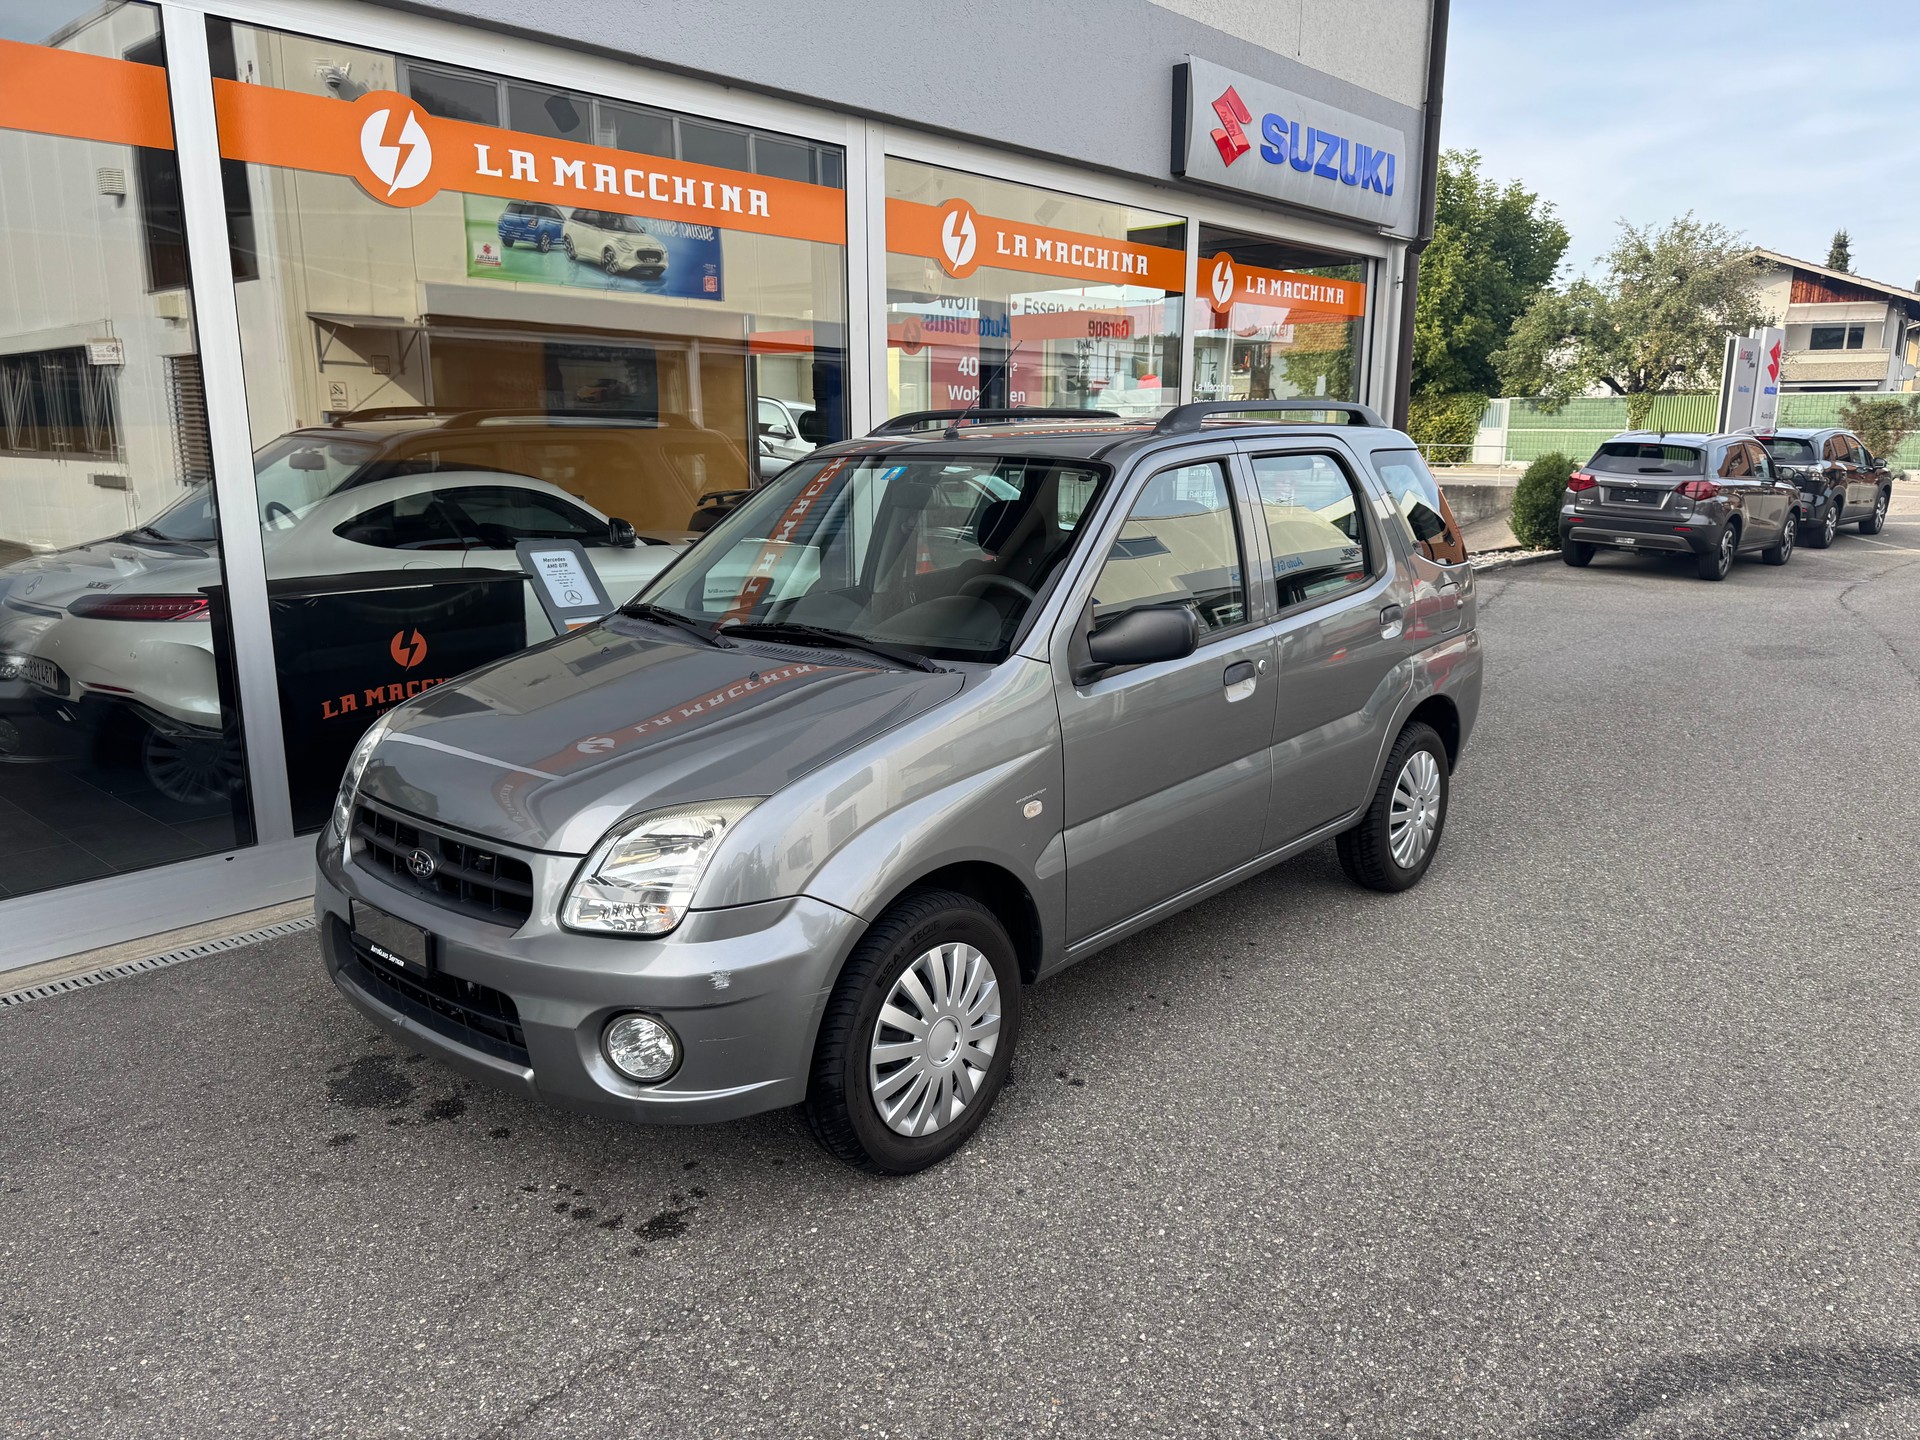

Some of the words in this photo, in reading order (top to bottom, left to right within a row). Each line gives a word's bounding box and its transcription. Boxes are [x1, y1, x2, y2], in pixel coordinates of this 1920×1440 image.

[1260, 112, 1396, 196] SUZUKI
[473, 143, 539, 183] LA
[551, 155, 770, 218] MACCHINA
[996, 231, 1028, 258] LA
[1034, 237, 1148, 276] MACCHINA
[1245, 275, 1266, 295] LA
[1269, 279, 1344, 304] MACCHINA
[321, 693, 359, 720] LA
[364, 677, 451, 707] MACC
